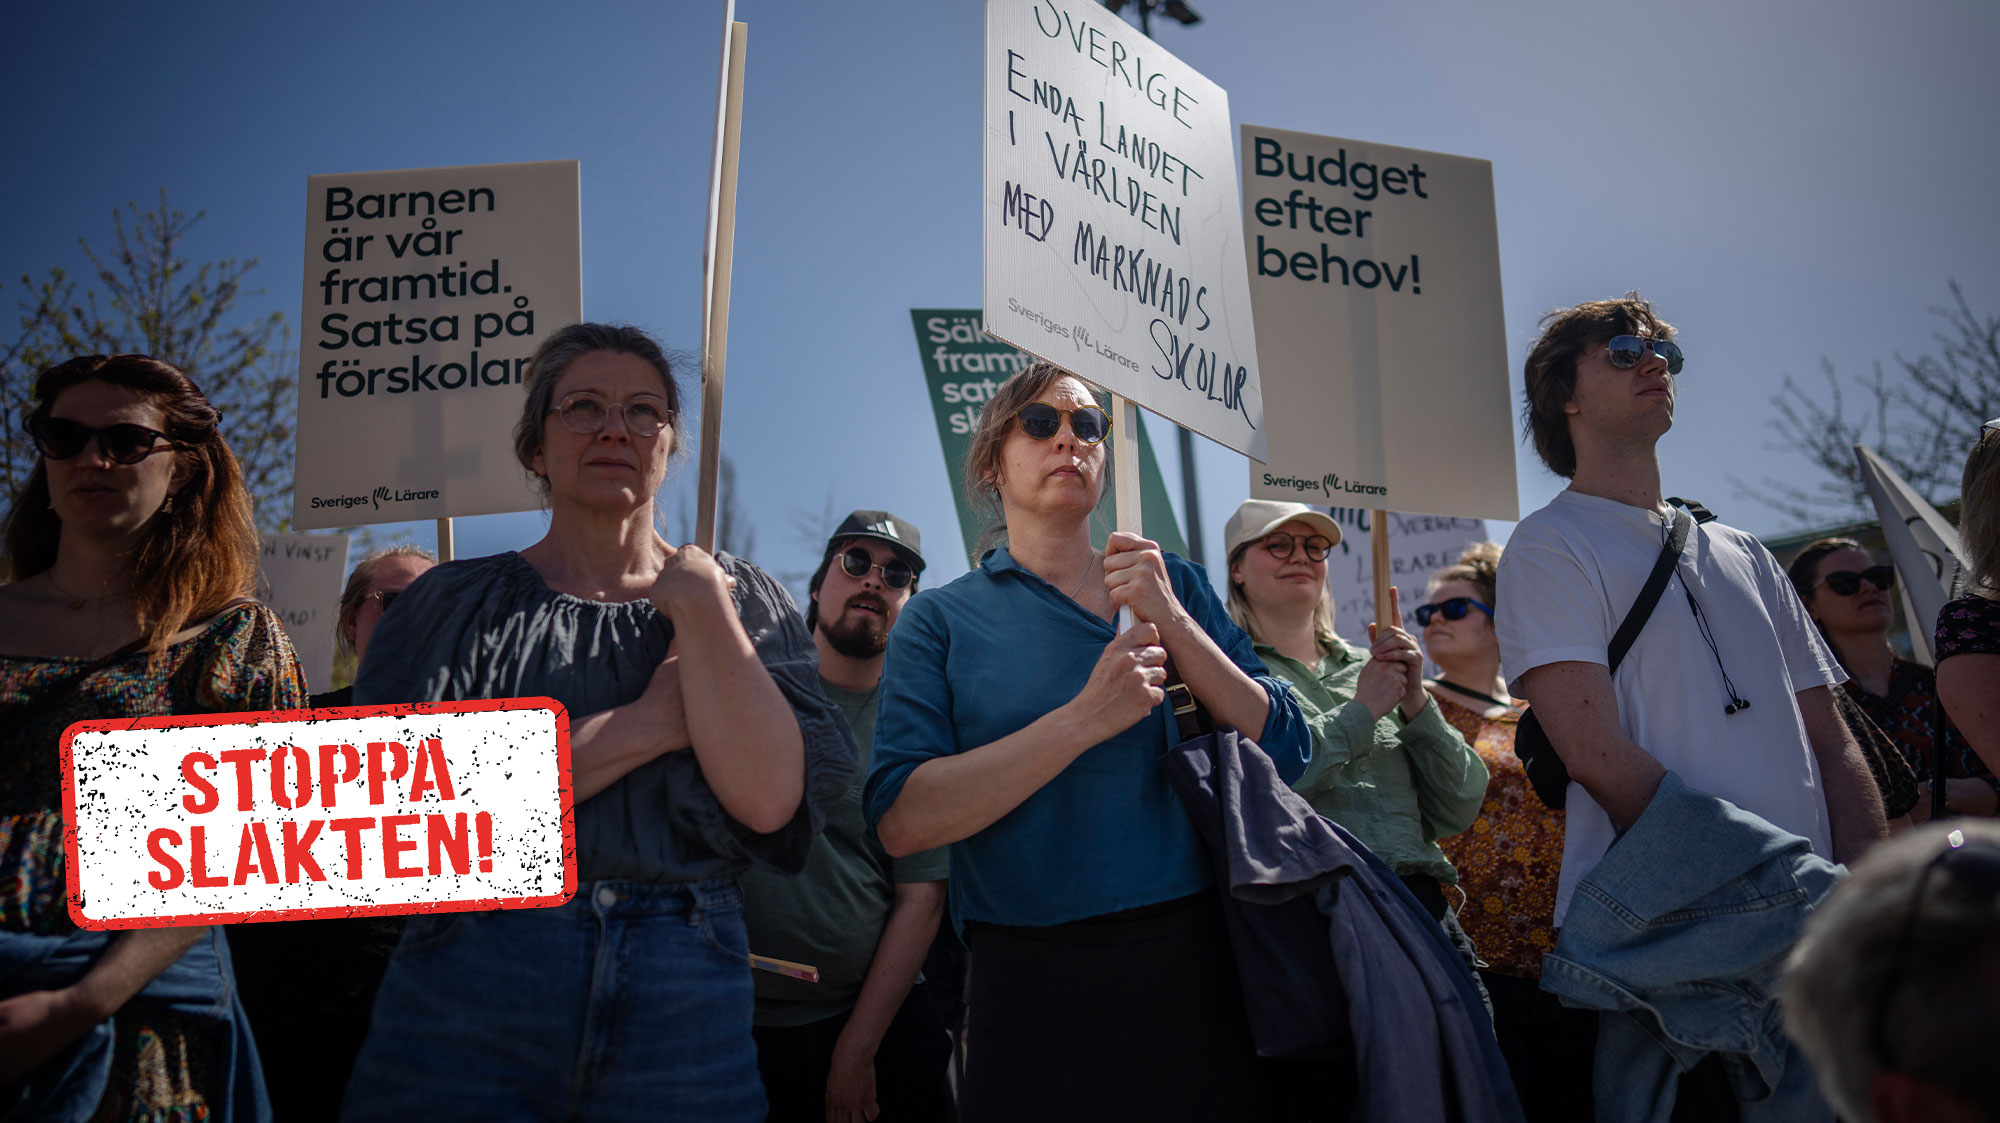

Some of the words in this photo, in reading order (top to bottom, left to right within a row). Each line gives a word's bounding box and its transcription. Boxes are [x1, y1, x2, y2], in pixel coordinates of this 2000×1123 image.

[1034, 0, 1199, 129] SVERIGE
[1007, 49, 1085, 136] ENDA
[1100, 101, 1204, 196] LANDET
[1008, 110, 1016, 146] I
[1045, 131, 1181, 246] VÄRLDEN
[1254, 136, 1428, 201] Budget
[326, 187, 495, 221] Barnen
[1255, 190, 1372, 238] efter
[322, 228, 374, 262] är
[385, 218, 463, 258] vår
[1003, 180, 1054, 242] MED
[1074, 220, 1210, 331] MARKNADS
[1257, 235, 1421, 295] behov!
[320, 259, 512, 305] framtid.
[318, 313, 459, 350] Satsa
[474, 296, 534, 347] på
[927, 317, 998, 344] Säk
[1008, 297, 1069, 338] Sveriges
[1095, 343, 1140, 373] Lärare
[1150, 318, 1256, 430] SKOLOR
[311, 494, 368, 509] Sveriges
[395, 488, 439, 502] Lärare
[1263, 473, 1320, 491] Sveriges
[1345, 480, 1387, 496] Lärare
[285, 540, 336, 563] VINST
